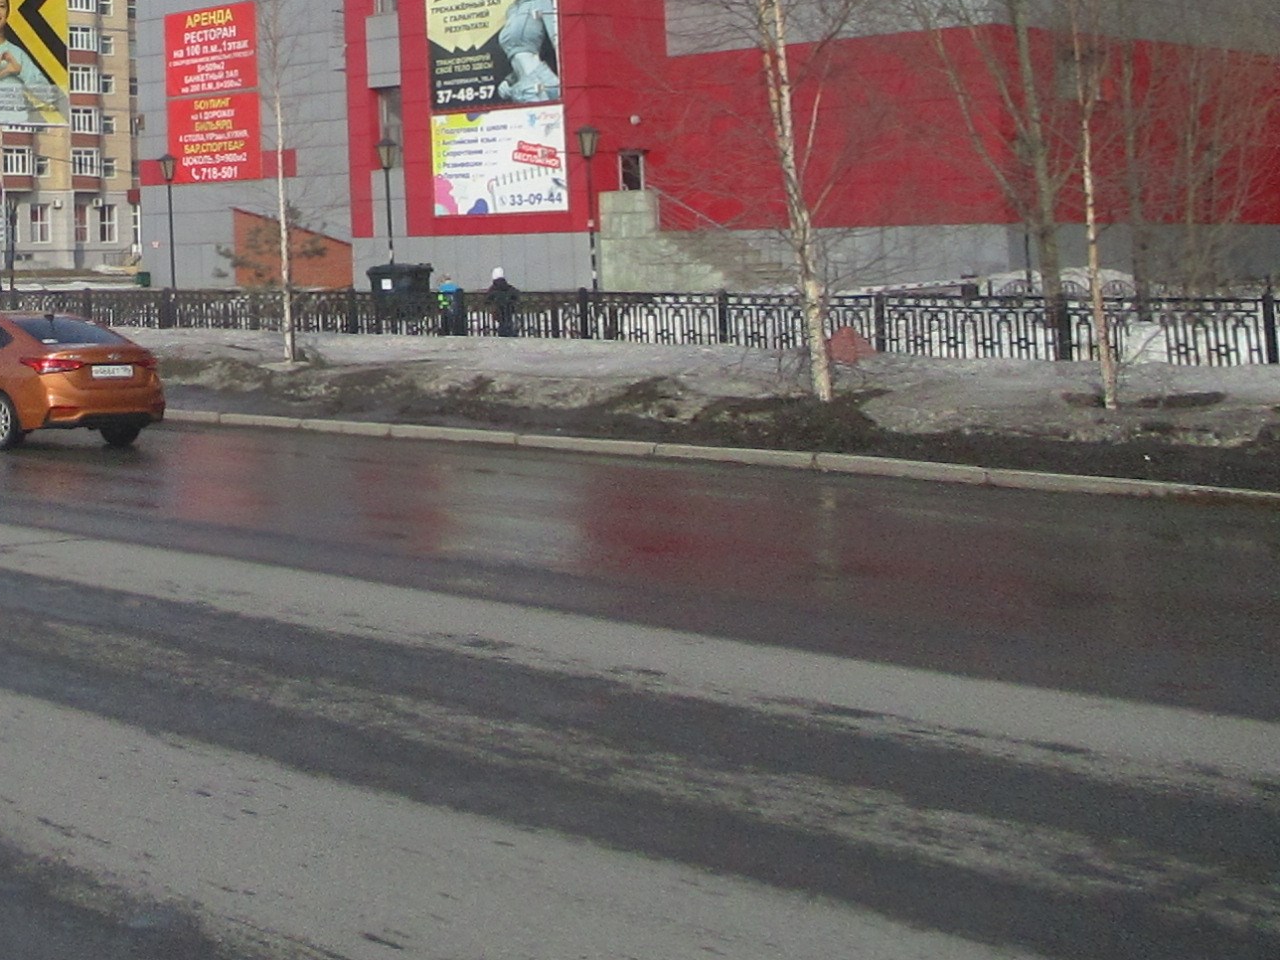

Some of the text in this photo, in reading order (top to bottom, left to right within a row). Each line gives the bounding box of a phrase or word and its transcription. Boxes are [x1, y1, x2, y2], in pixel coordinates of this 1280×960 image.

[185, 8, 234, 29] АРЕНДА
[183, 25, 237, 44] РЕСТОРАН
[436, 85, 495, 104] 37-48-57
[201, 166, 238, 179] 718-501
[509, 192, 563, 207] 33-09-44
